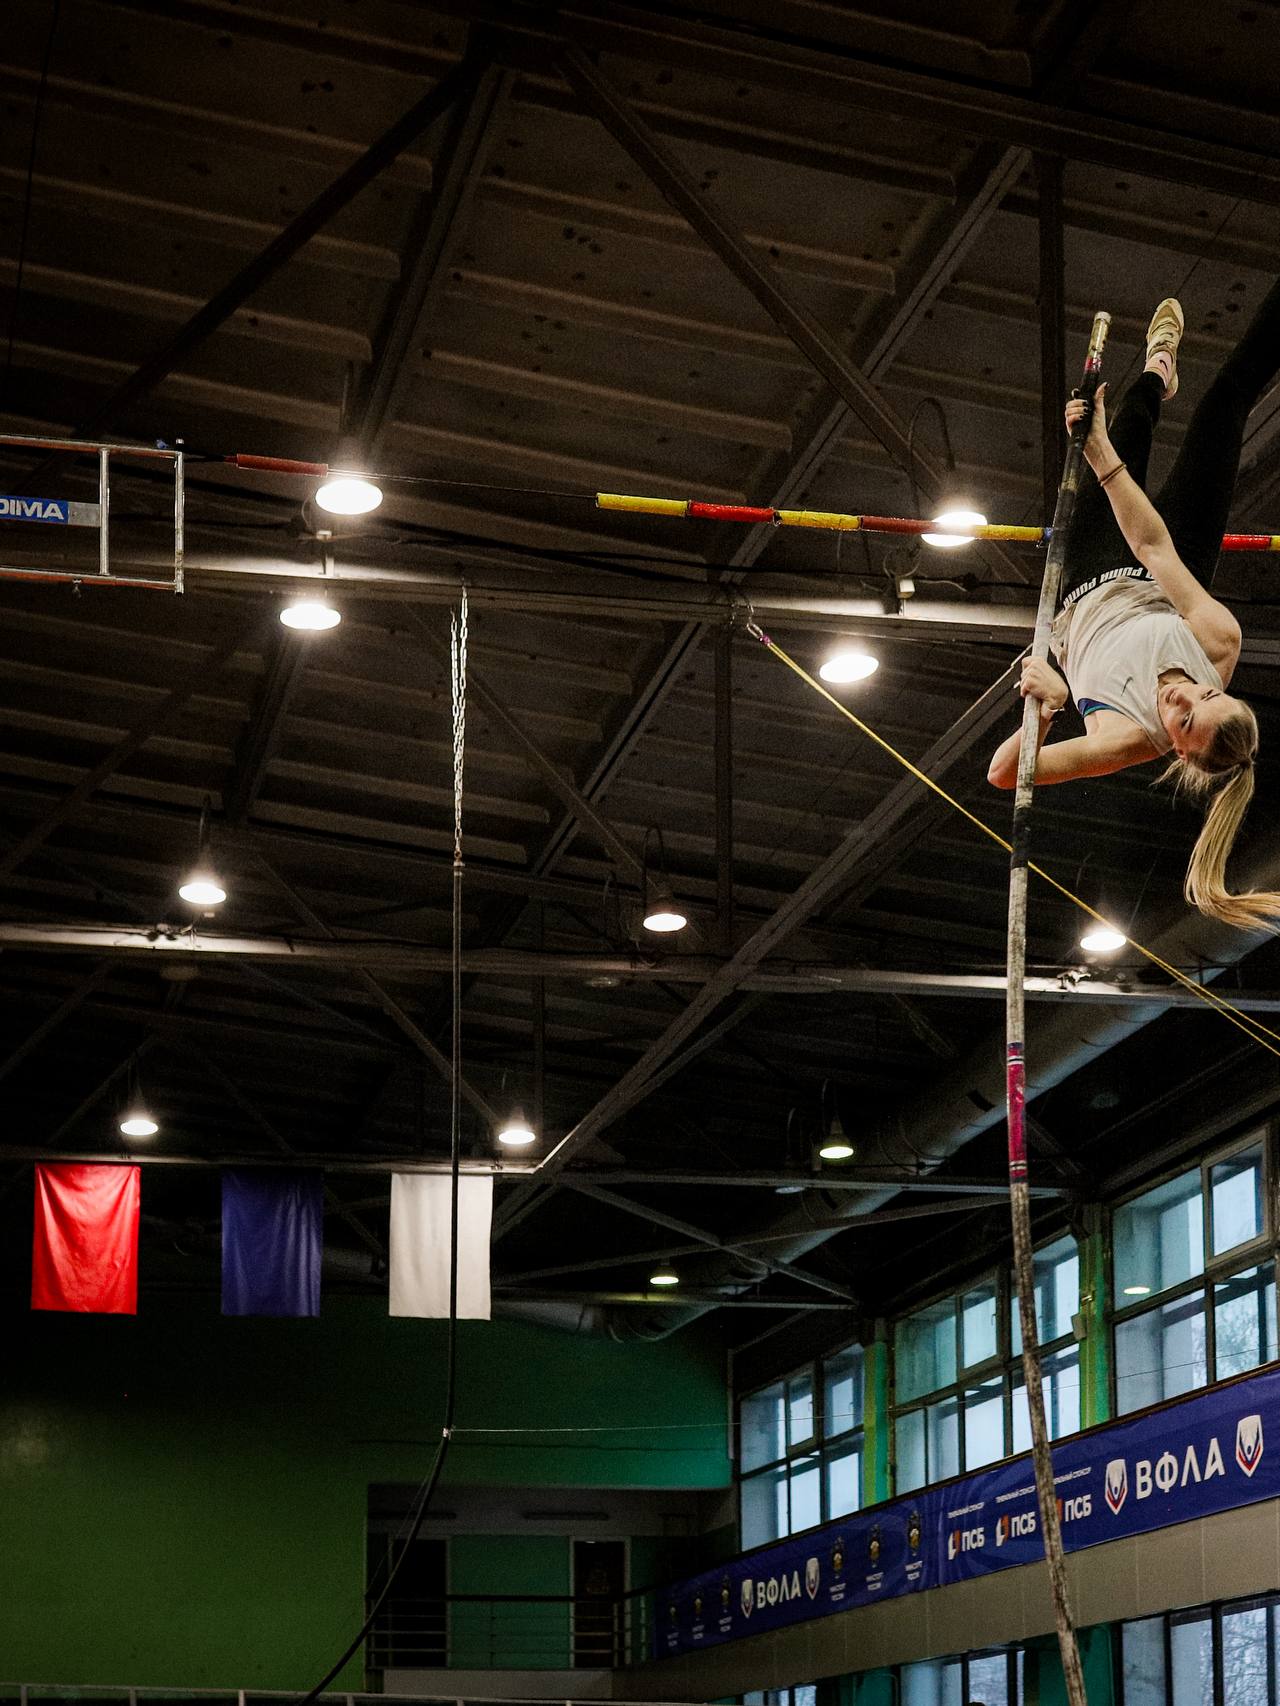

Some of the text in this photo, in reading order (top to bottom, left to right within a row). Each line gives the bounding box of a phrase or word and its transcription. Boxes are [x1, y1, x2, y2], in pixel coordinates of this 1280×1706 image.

[1135, 1437, 1226, 1500] ВФЛА
[1065, 1494, 1092, 1522] ПСБ
[1011, 1511, 1036, 1538] ПСБ
[962, 1527, 985, 1552] ПСБ
[757, 1570, 801, 1609] ВФЛА
